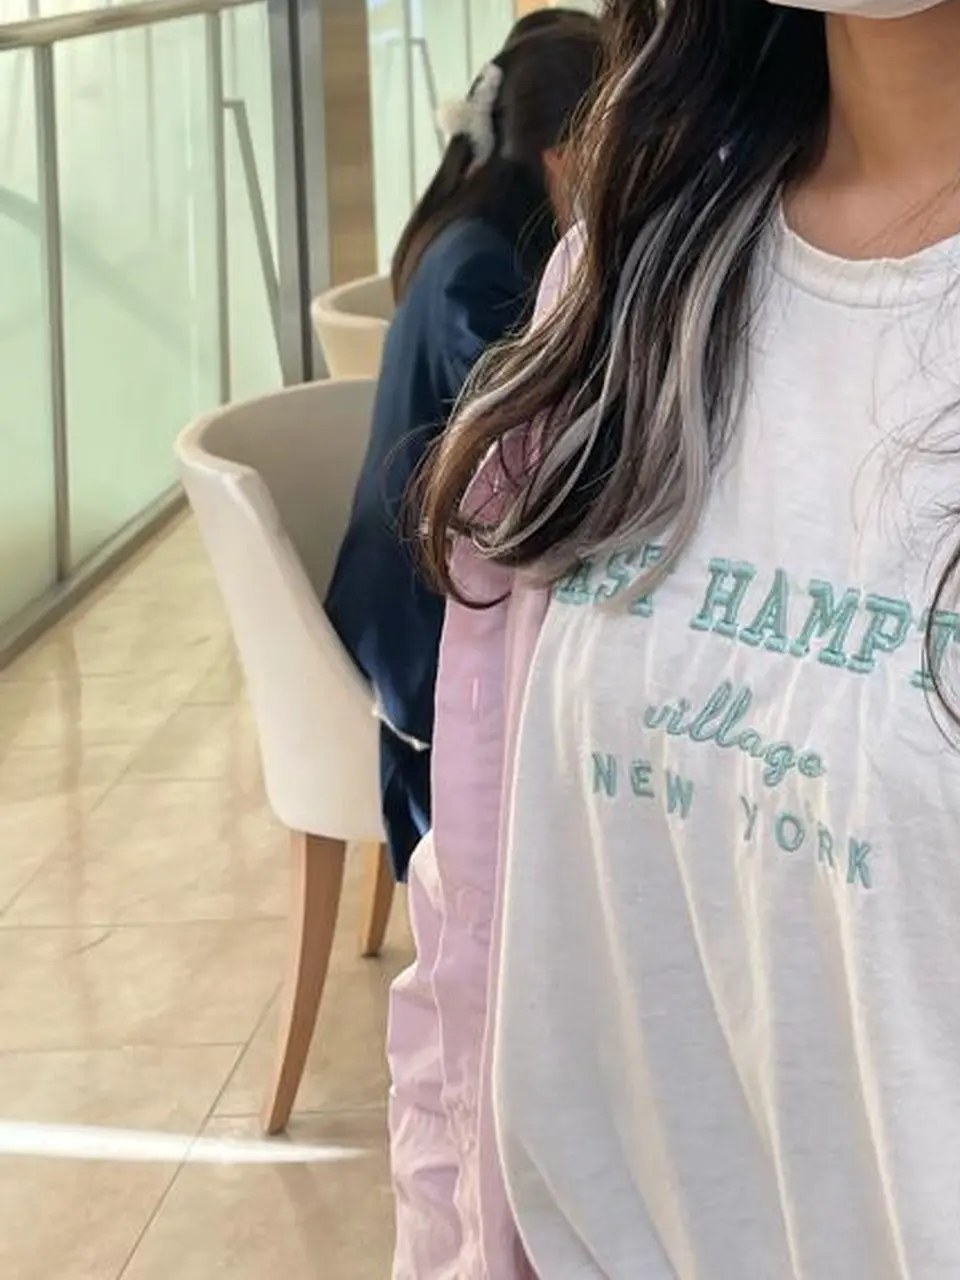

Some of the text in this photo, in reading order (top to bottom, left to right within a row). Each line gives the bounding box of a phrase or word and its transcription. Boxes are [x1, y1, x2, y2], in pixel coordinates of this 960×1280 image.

[643, 681, 826, 787] village
[592, 752, 872, 889] NEW YORK
